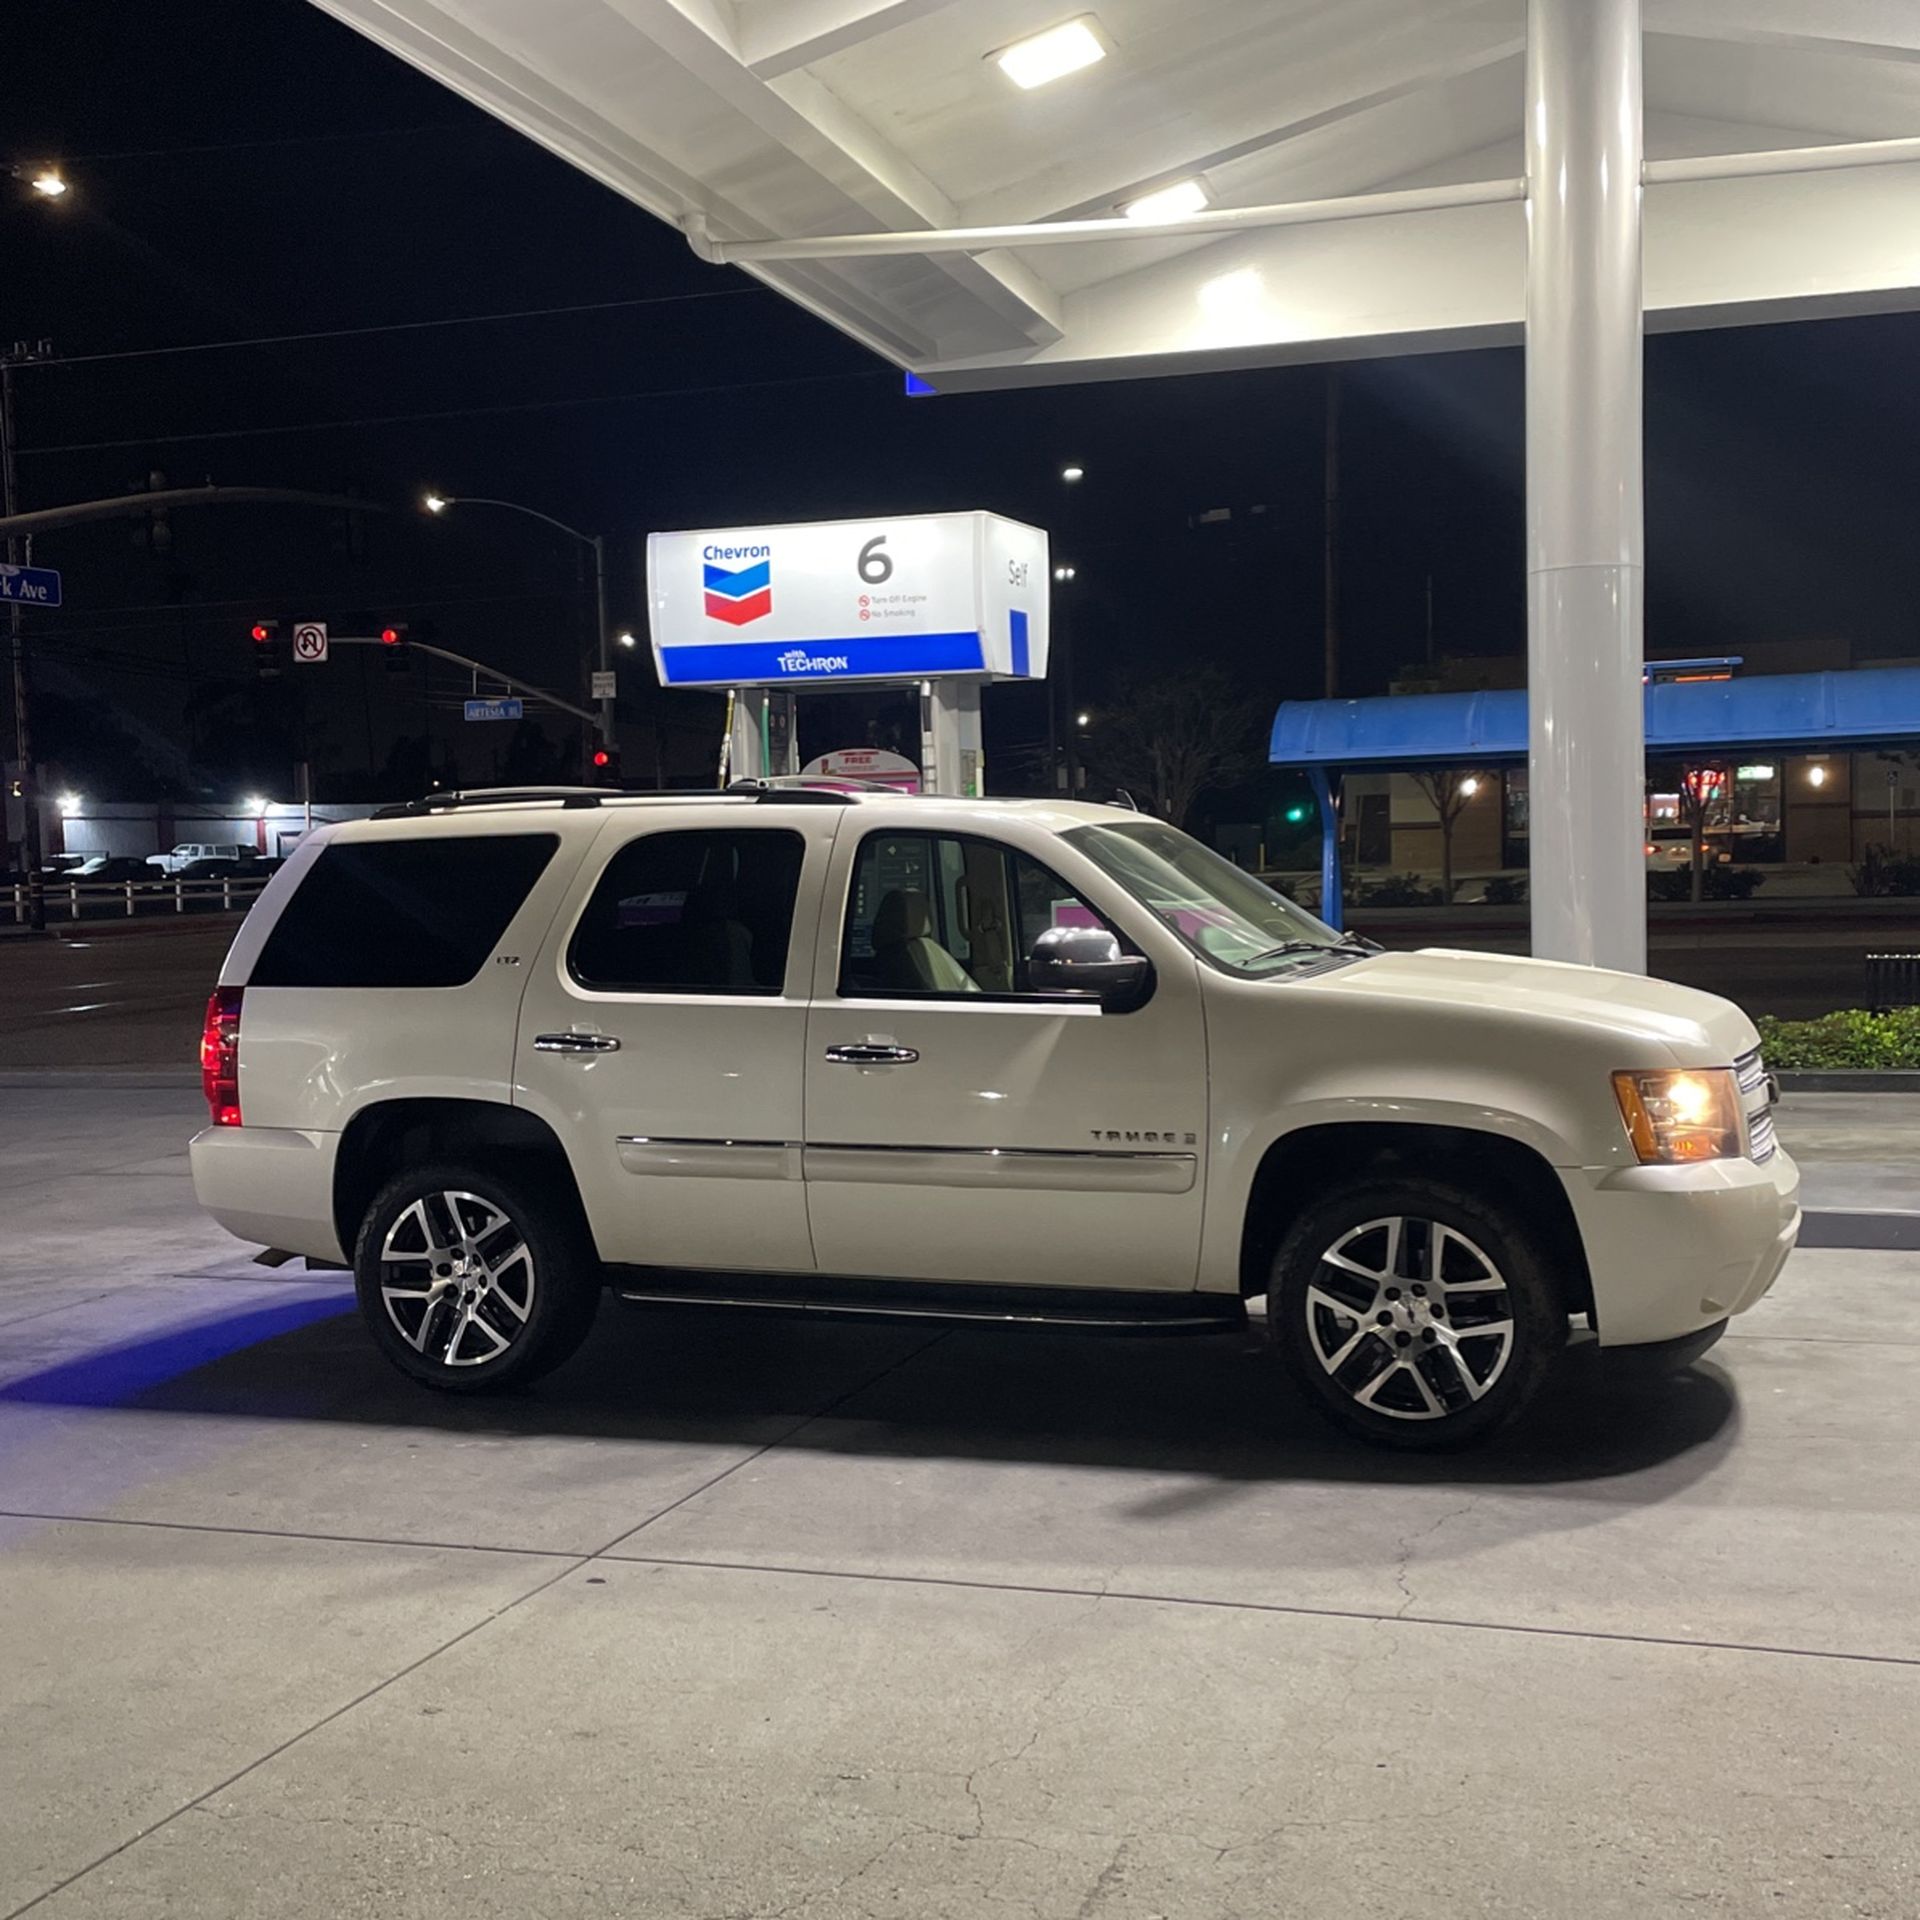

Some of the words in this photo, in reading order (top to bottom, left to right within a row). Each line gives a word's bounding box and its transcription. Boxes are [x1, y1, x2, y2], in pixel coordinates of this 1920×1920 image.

[703, 544, 771, 561] Chevron
[858, 535, 893, 585] 6
[1008, 559, 1029, 589] Self
[19, 579, 48, 600] Ave
[902, 594, 928, 604] Engine
[883, 608, 916, 618] Smoking
[777, 656, 849, 673] TECHRON
[844, 756, 873, 765] FREE
